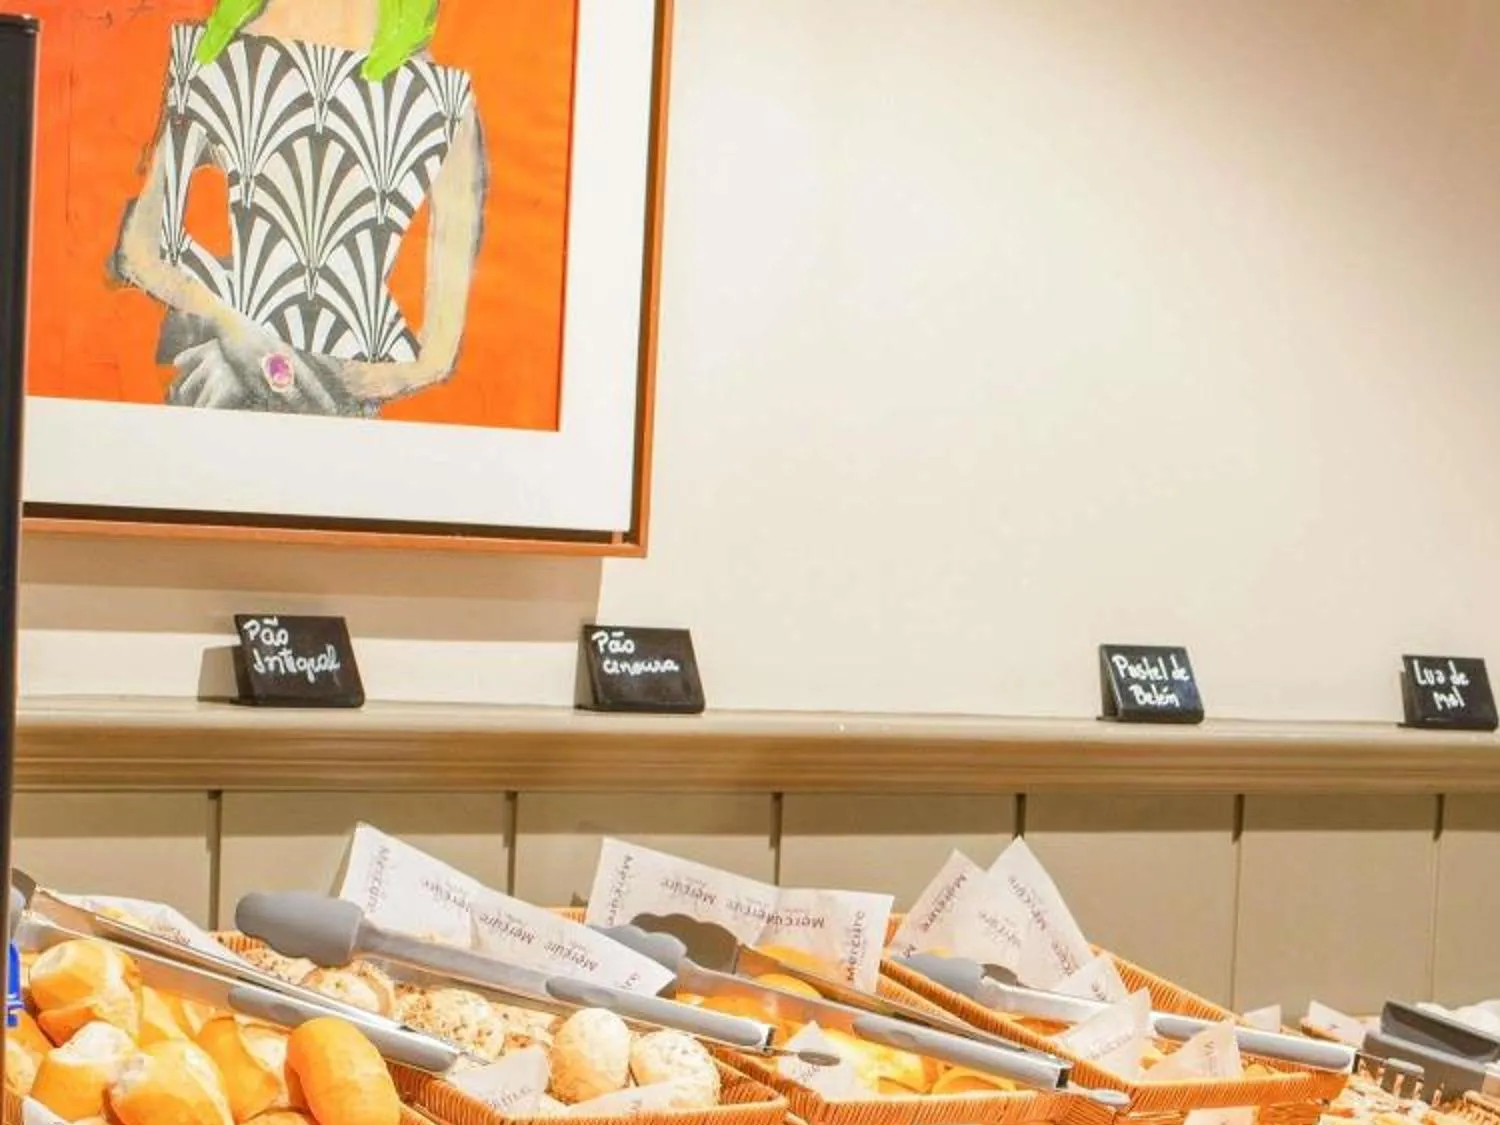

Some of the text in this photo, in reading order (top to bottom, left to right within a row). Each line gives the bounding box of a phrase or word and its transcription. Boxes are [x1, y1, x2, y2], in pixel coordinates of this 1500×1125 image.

[243, 617, 290, 646] Pão
[591, 629, 636, 654] Pão
[252, 644, 342, 684] Integral
[1111, 653, 1191, 682] Pastel de
[1447, 660, 1469, 686] de
[846, 911, 866, 982] Mercure
